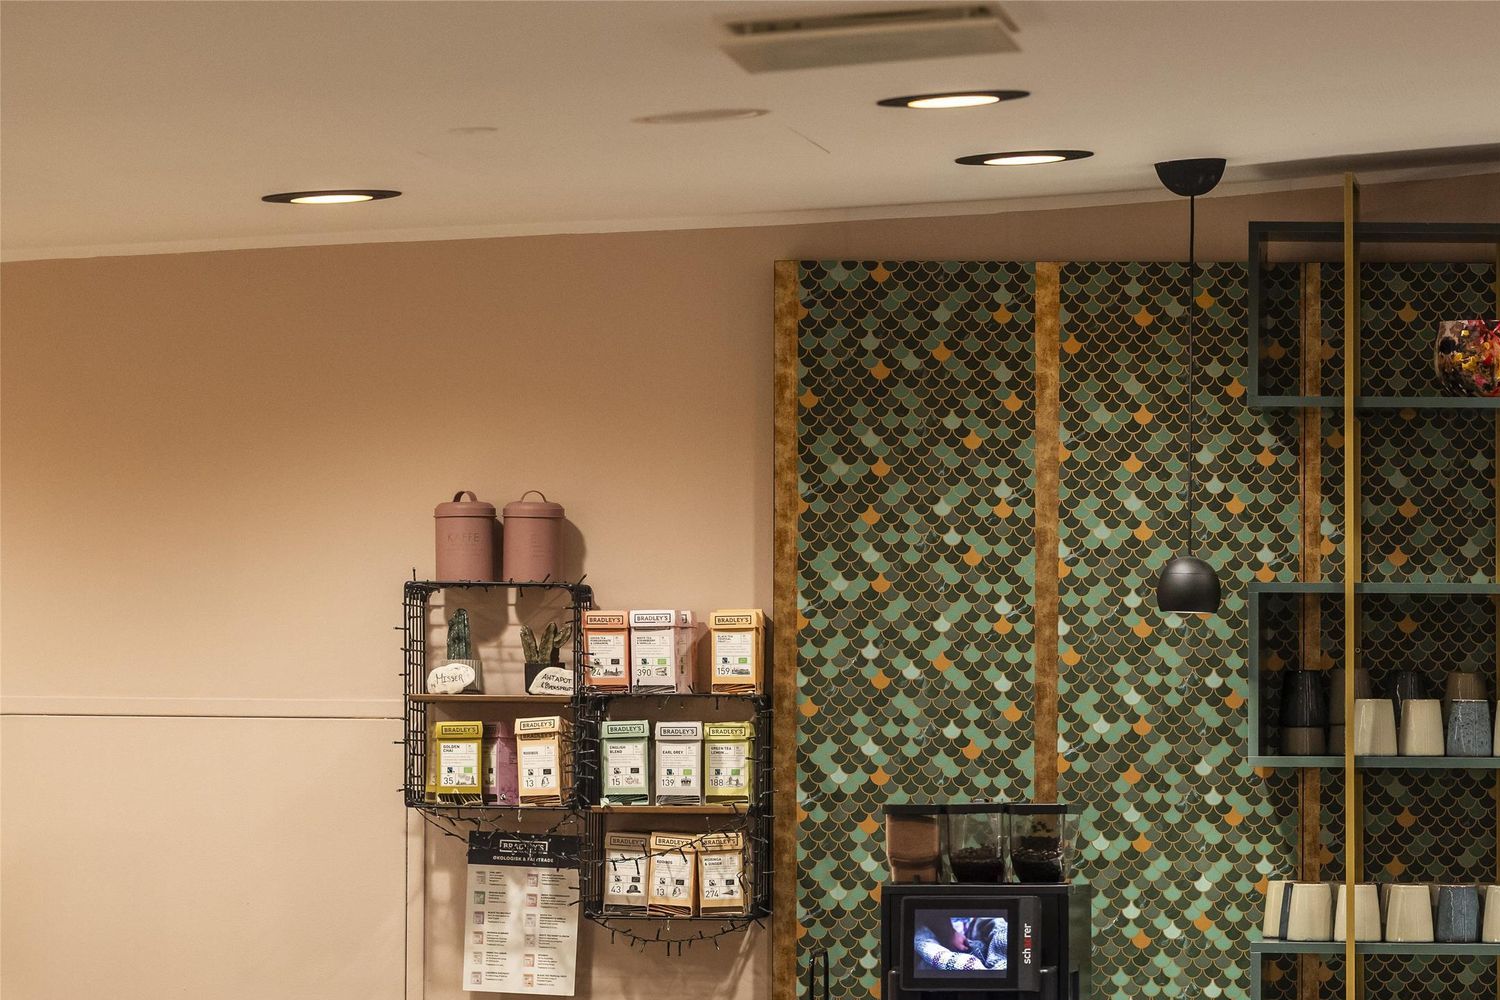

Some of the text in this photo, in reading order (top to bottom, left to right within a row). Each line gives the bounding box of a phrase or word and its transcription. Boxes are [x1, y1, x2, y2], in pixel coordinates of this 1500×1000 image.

[637, 668, 652, 677] 390
[717, 667, 730, 675] 159
[443, 777, 454, 785] 35
[525, 779, 535, 788] 13
[612, 778, 621, 786] 15
[662, 778, 675, 787] 139
[710, 778, 724, 787] 188
[611, 885, 622, 893] 43
[656, 888, 665, 896] 13
[705, 890, 719, 898] 274
